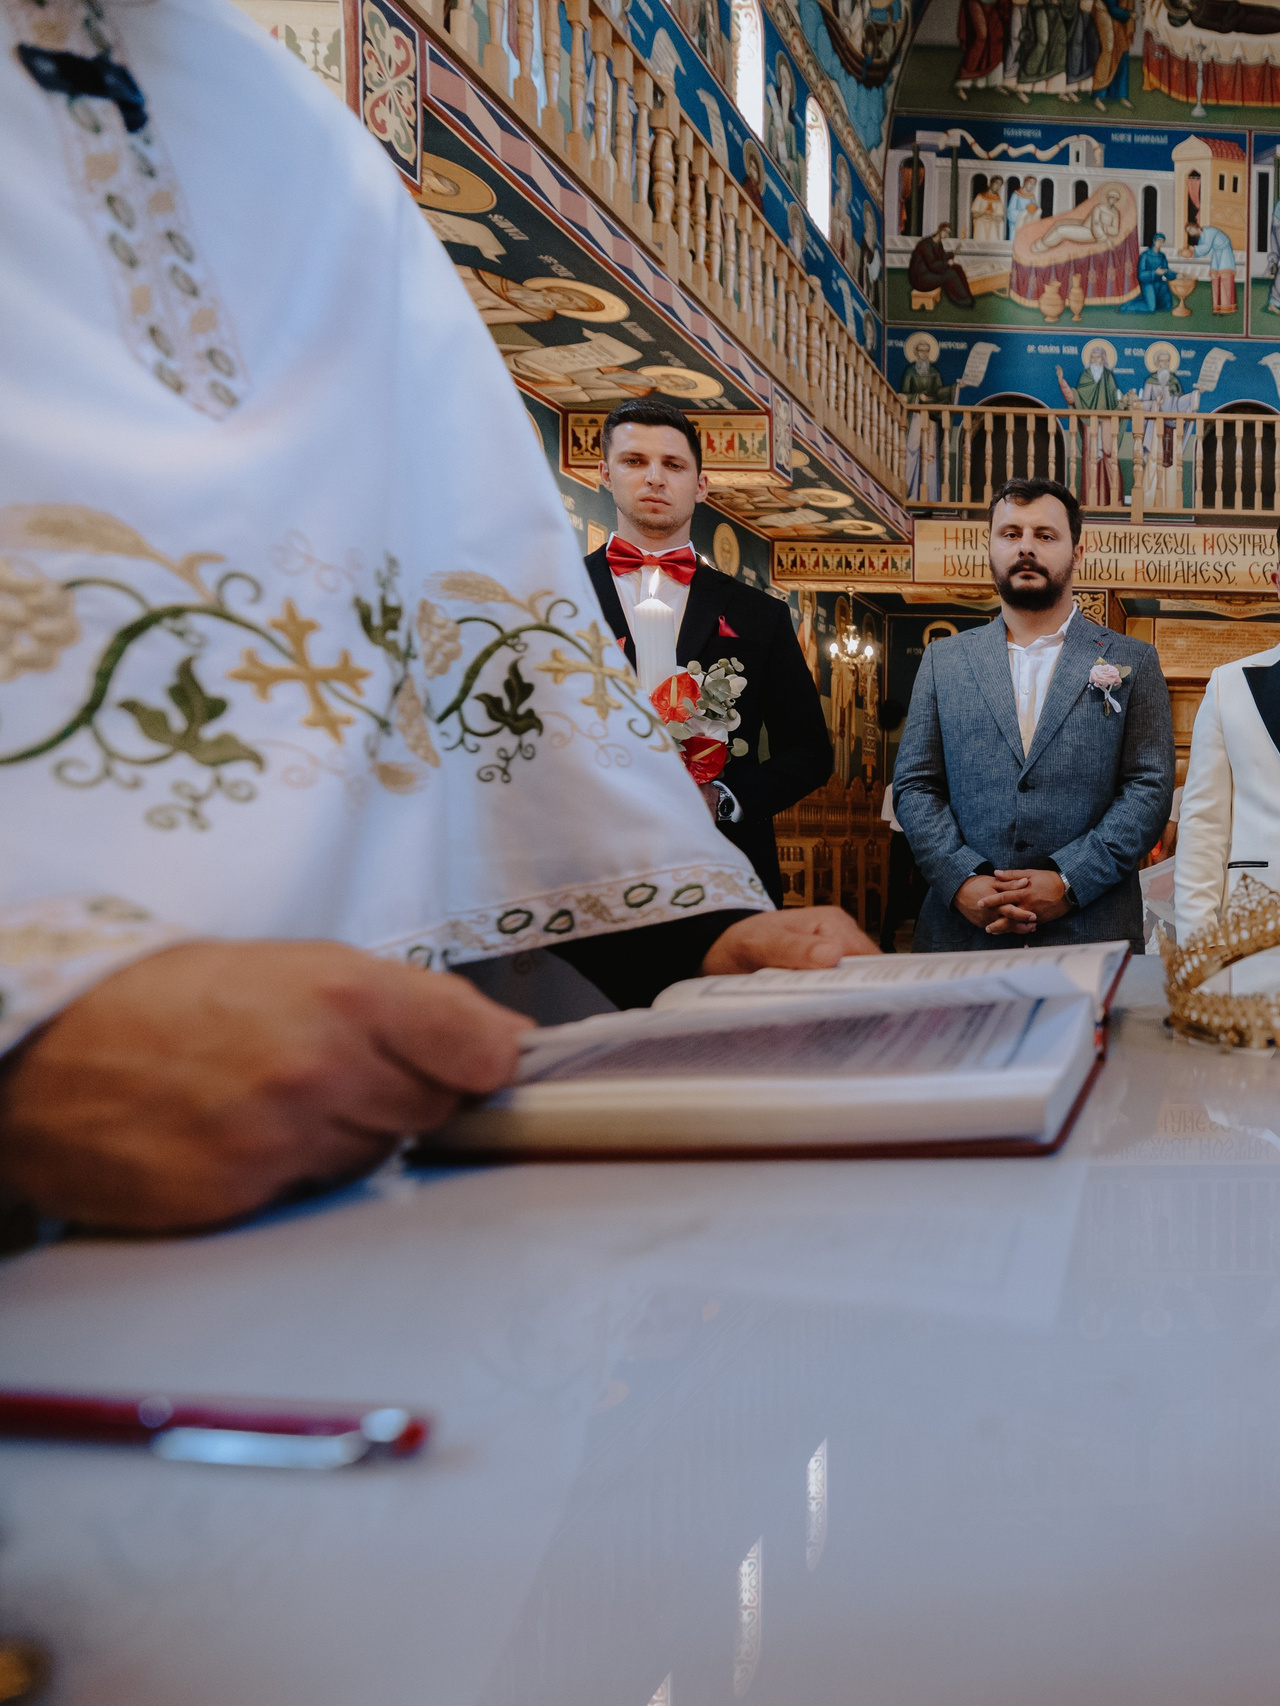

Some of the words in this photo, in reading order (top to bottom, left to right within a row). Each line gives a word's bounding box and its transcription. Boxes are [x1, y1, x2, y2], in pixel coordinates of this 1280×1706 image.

[1085, 530, 1197, 556] DUMNEZEUL
[1203, 532, 1276, 557] NOSTRU
[1248, 561, 1279, 586] CE
